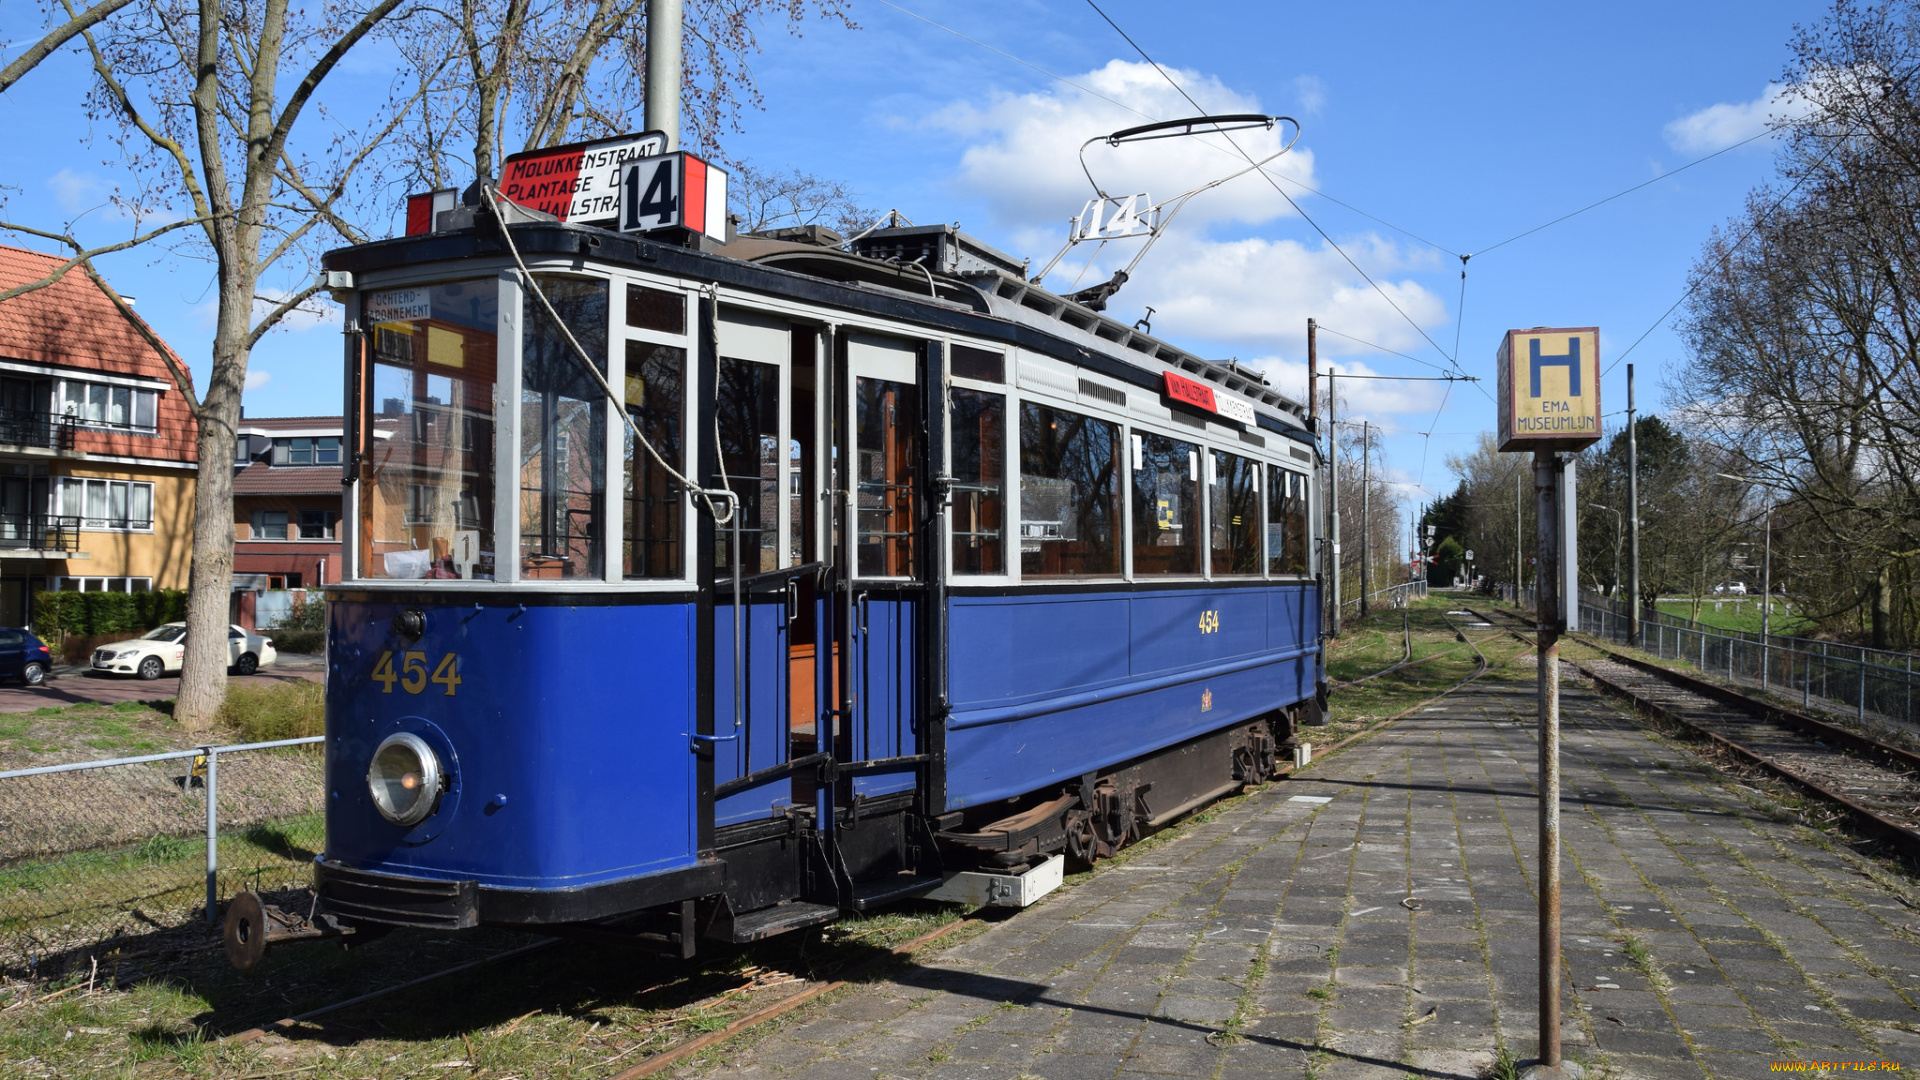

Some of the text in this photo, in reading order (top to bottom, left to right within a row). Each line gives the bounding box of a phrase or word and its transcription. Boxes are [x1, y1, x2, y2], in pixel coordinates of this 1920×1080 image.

[511, 142, 656, 180] MOLUKKENSTRAAT
[506, 176, 591, 201] PLANTAGE
[624, 159, 677, 230] 14
[1084, 194, 1140, 239] 14
[369, 304, 429, 321] ABONNEMENT
[376, 291, 421, 306] OCHTEND-
[1529, 337, 1581, 398] H
[1542, 401, 1570, 413] EMA
[1198, 610, 1219, 635] 454
[371, 650, 462, 696] 454
